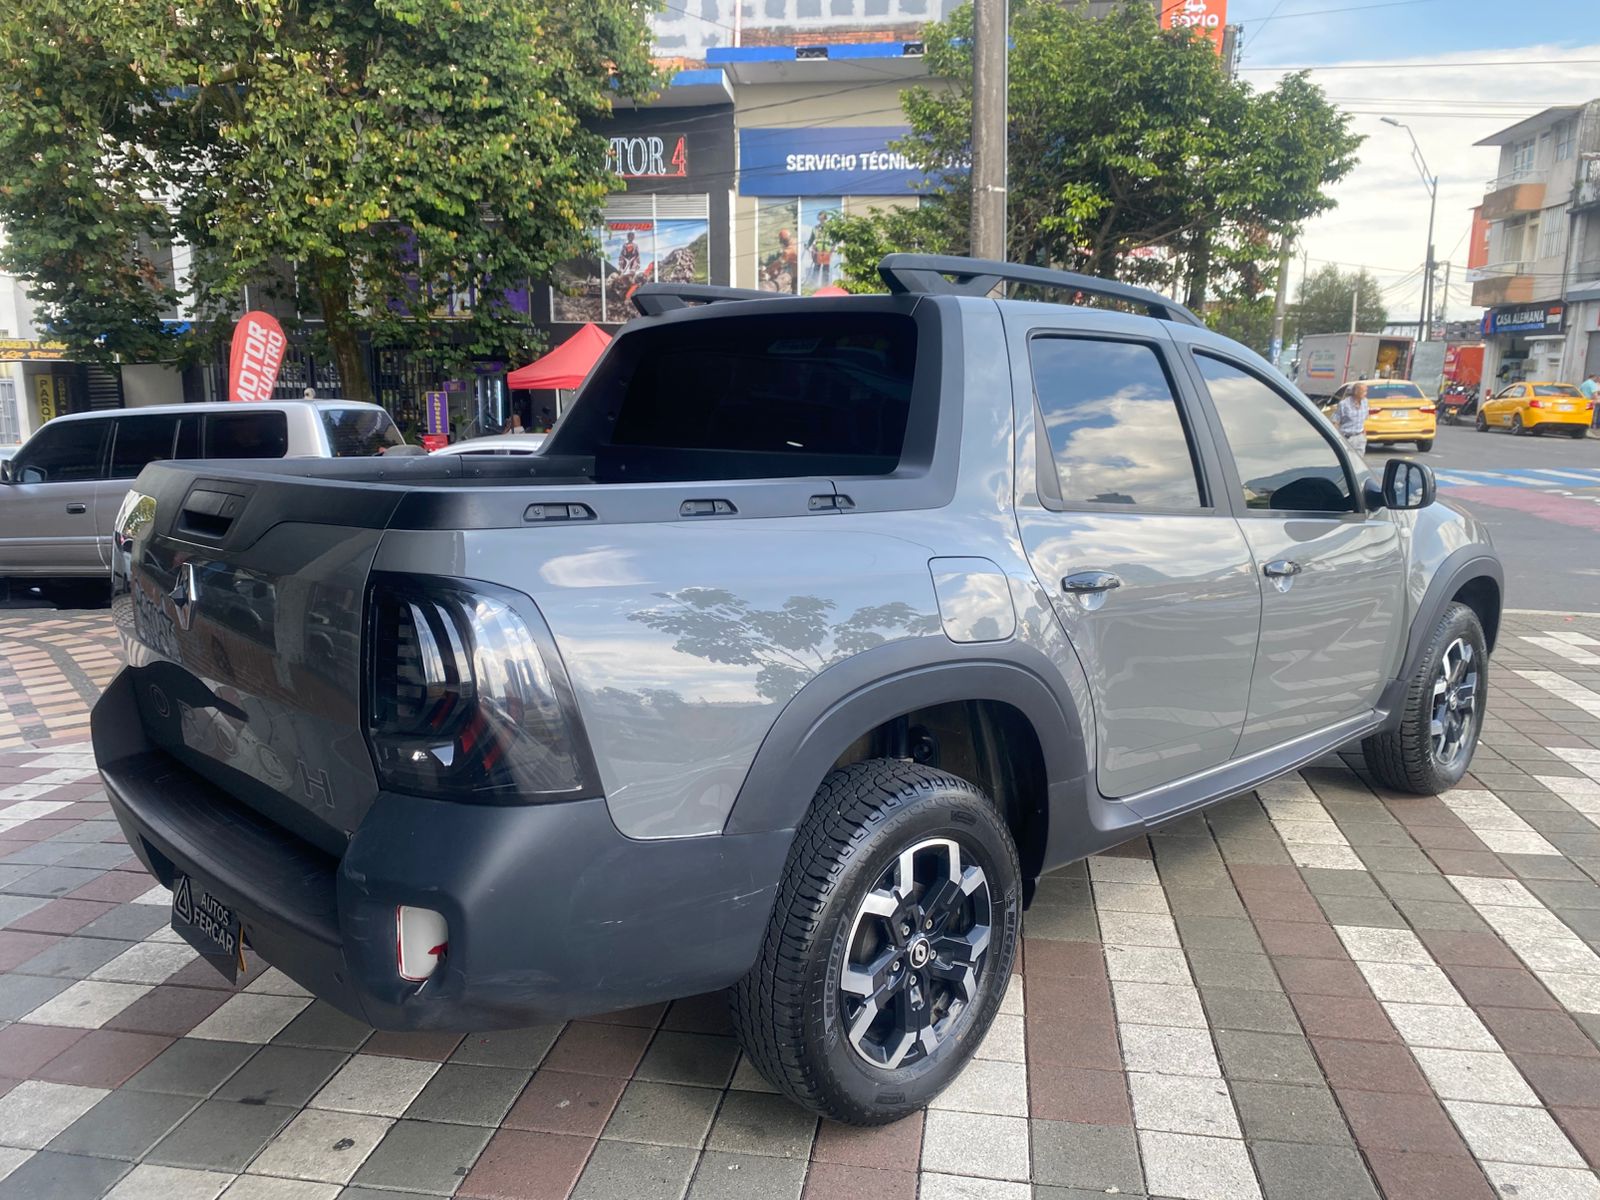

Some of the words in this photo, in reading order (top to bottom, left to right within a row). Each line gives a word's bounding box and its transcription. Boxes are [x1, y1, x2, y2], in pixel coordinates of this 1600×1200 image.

[671, 136, 687, 176] 4
[786, 154, 857, 171] SERVICIO
[1496, 314, 1512, 326] CASA
[1512, 310, 1545, 324] ALEMANA
[257, 330, 283, 401] CUATRO
[201, 893, 229, 926] AUTOS
[193, 906, 234, 955] FERCAR
